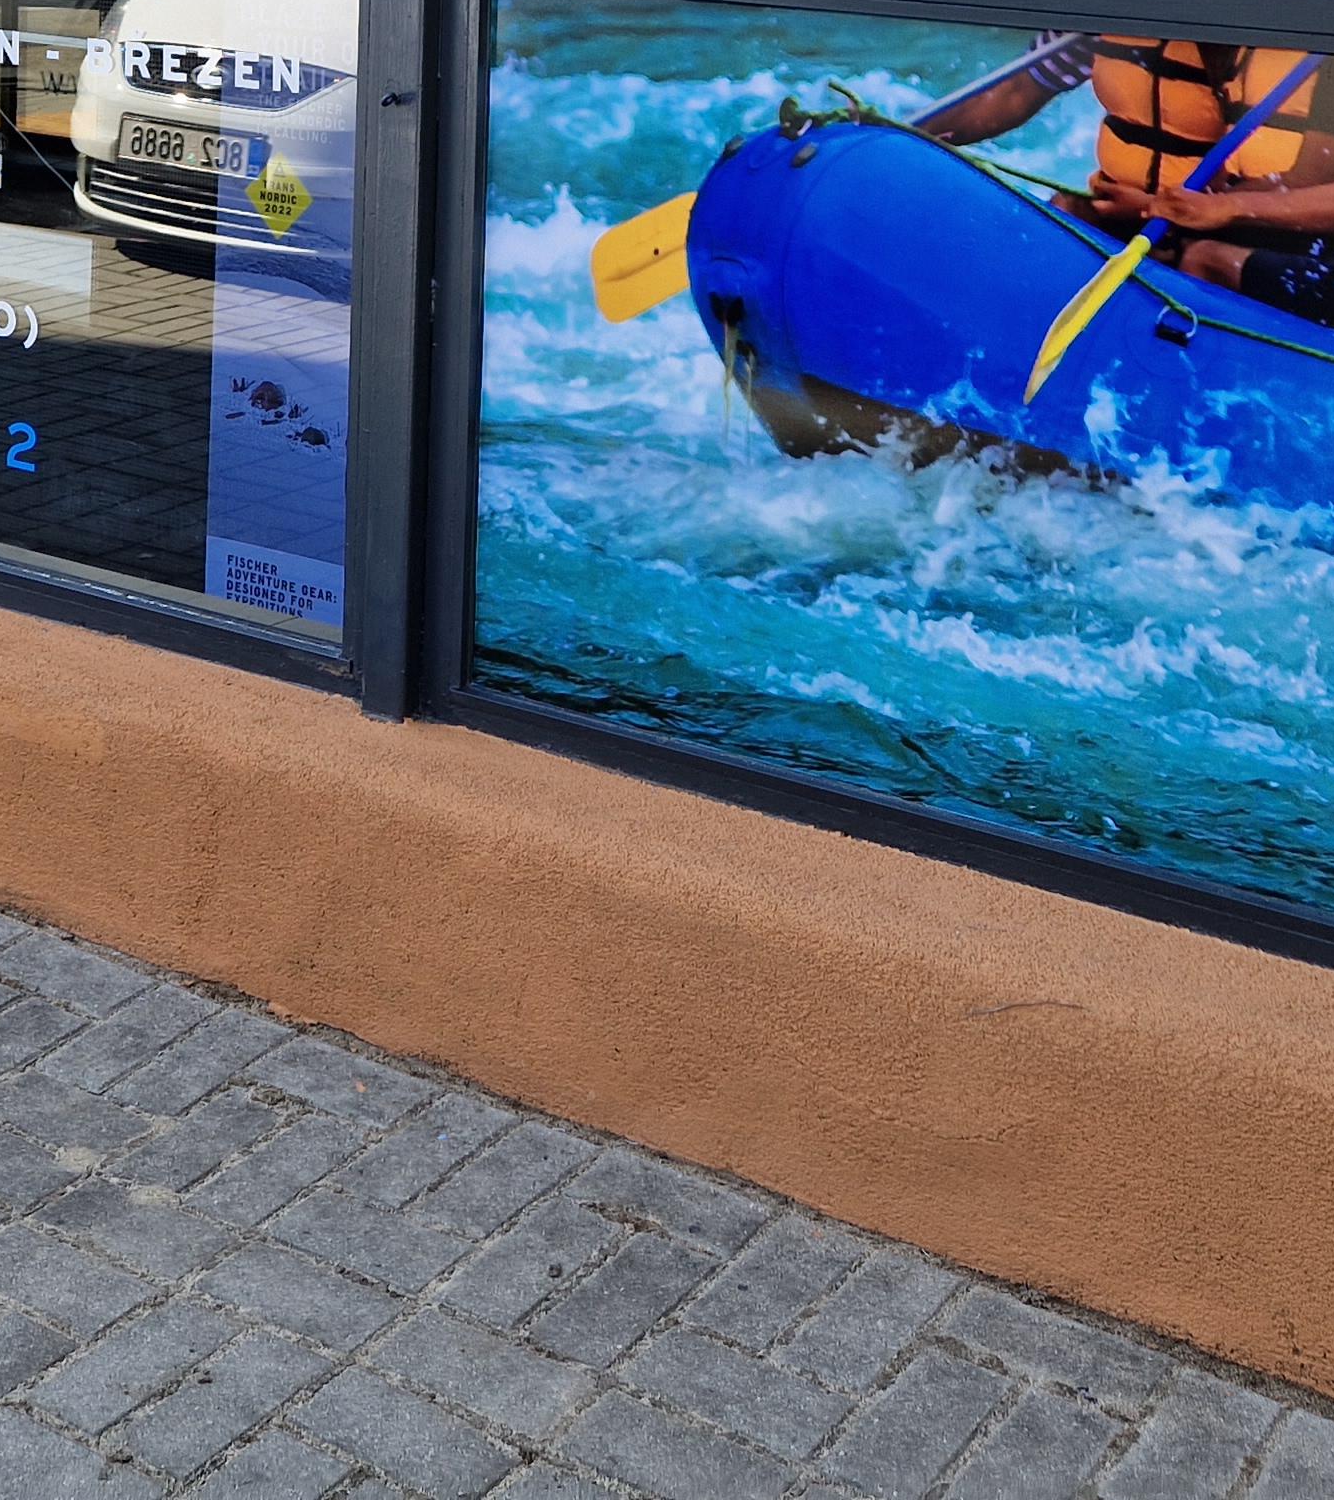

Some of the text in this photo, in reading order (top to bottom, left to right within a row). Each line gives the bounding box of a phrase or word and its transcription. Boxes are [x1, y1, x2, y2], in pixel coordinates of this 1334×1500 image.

[46, 49, 60, 60] -
[87, 30, 302, 94] BŘEZEN
[263, 180, 295, 193] TRANS
[259, 191, 298, 205] NORDIC
[265, 203, 292, 215] 2022
[227, 554, 278, 576] FISCHER
[227, 567, 338, 604] ADVENTURE GEAR:
[227, 579, 313, 611] DESIGNED FOR
